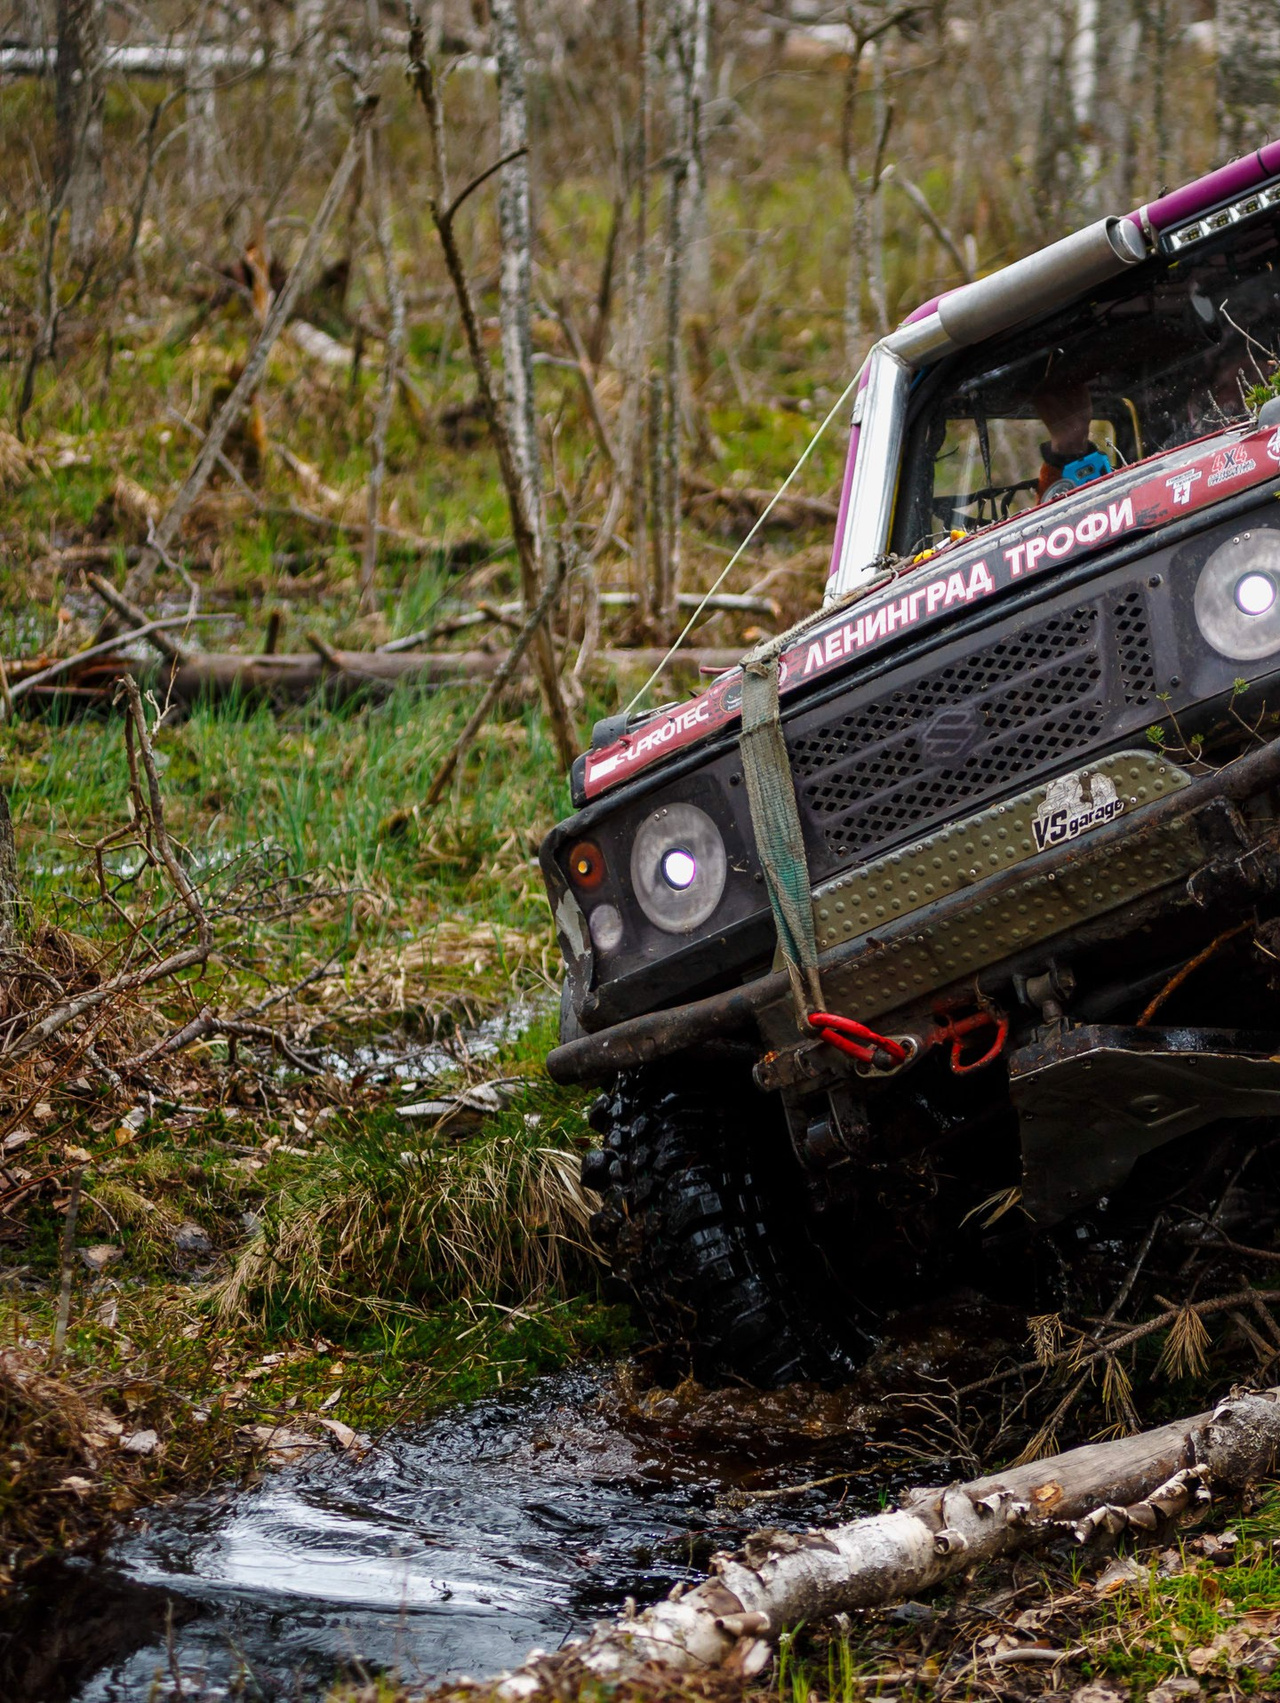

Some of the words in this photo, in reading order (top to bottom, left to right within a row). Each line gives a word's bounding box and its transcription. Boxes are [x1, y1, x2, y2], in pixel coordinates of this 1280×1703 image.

[802, 560, 994, 675] ЛЕНИНГРАД
[1004, 497, 1136, 577] ТРОФИ
[1034, 809, 1067, 849] VS
[1069, 800, 1124, 836] garage
